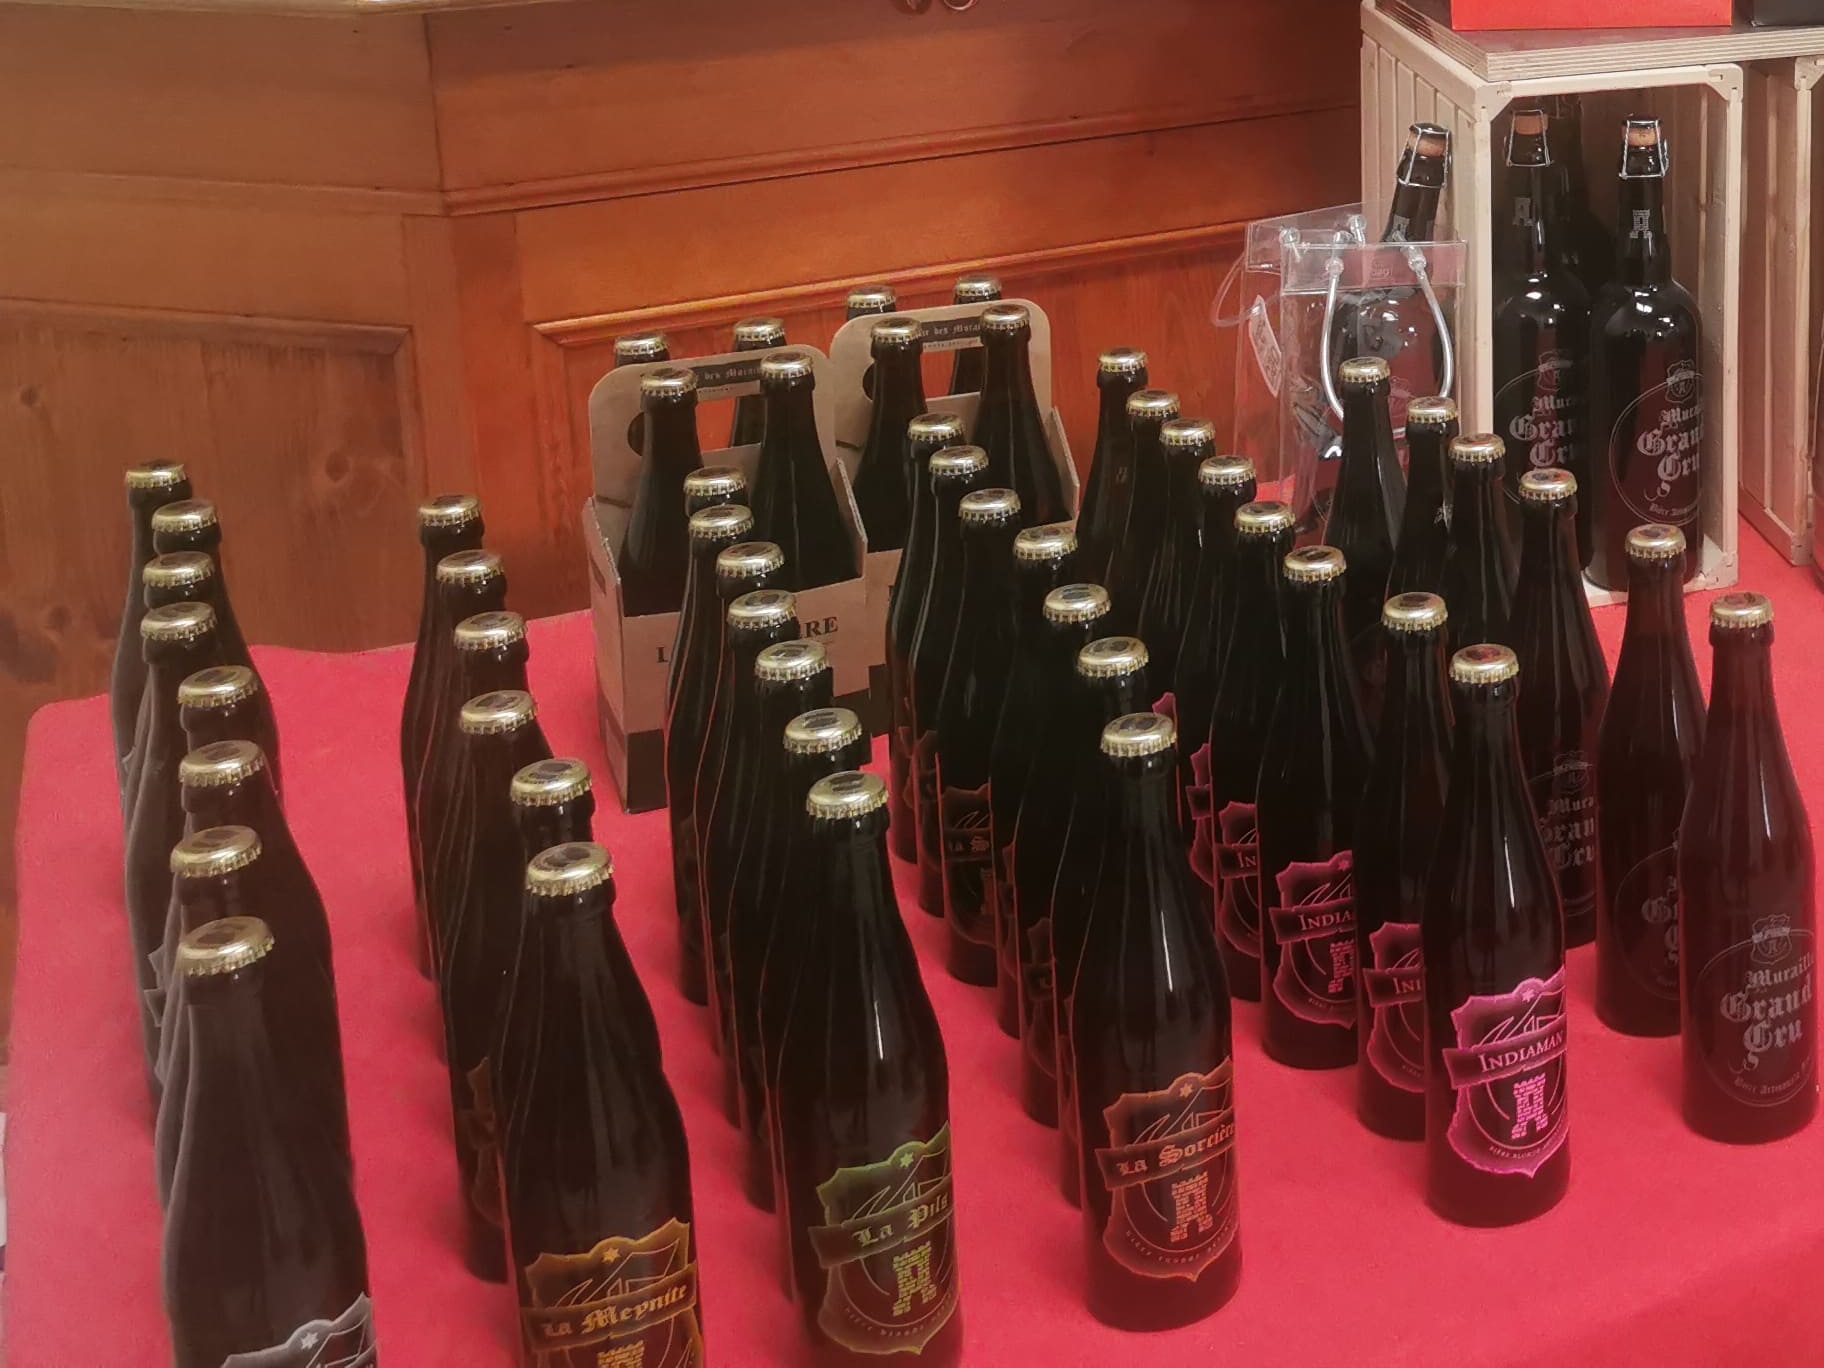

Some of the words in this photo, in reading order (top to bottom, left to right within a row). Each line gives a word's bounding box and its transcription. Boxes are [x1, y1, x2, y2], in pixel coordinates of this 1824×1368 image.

[1509, 414, 1574, 442] Gra
[1298, 908, 1352, 931] INDIA
[1720, 976, 1814, 1023] Grand
[1743, 1018, 1803, 1053] Cru
[1117, 1159, 1149, 1177] La
[852, 1224, 894, 1247] La
[906, 1192, 949, 1230] Pils
[543, 1318, 572, 1338] La
[581, 1283, 689, 1335] Meynite
